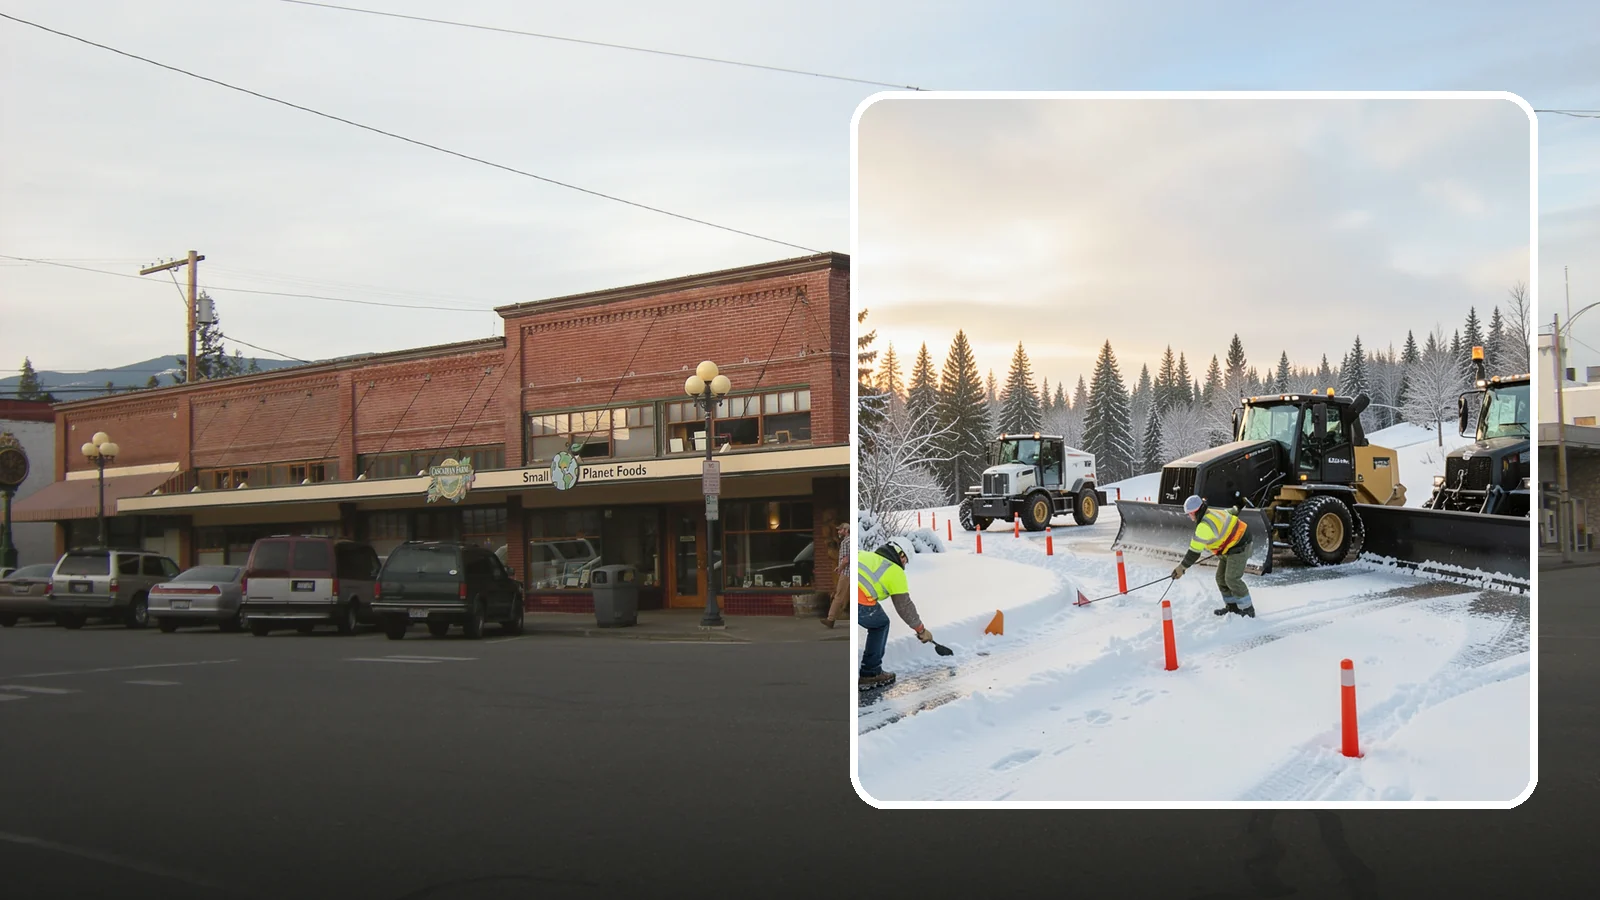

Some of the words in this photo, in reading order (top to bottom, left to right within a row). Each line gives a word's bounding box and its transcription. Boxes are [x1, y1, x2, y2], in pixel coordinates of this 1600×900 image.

[431, 467, 455, 476] CASCADIAN
[455, 466, 469, 474] FARM
[523, 471, 549, 483] Small
[583, 468, 614, 479] Planet
[617, 464, 647, 477] Foods
